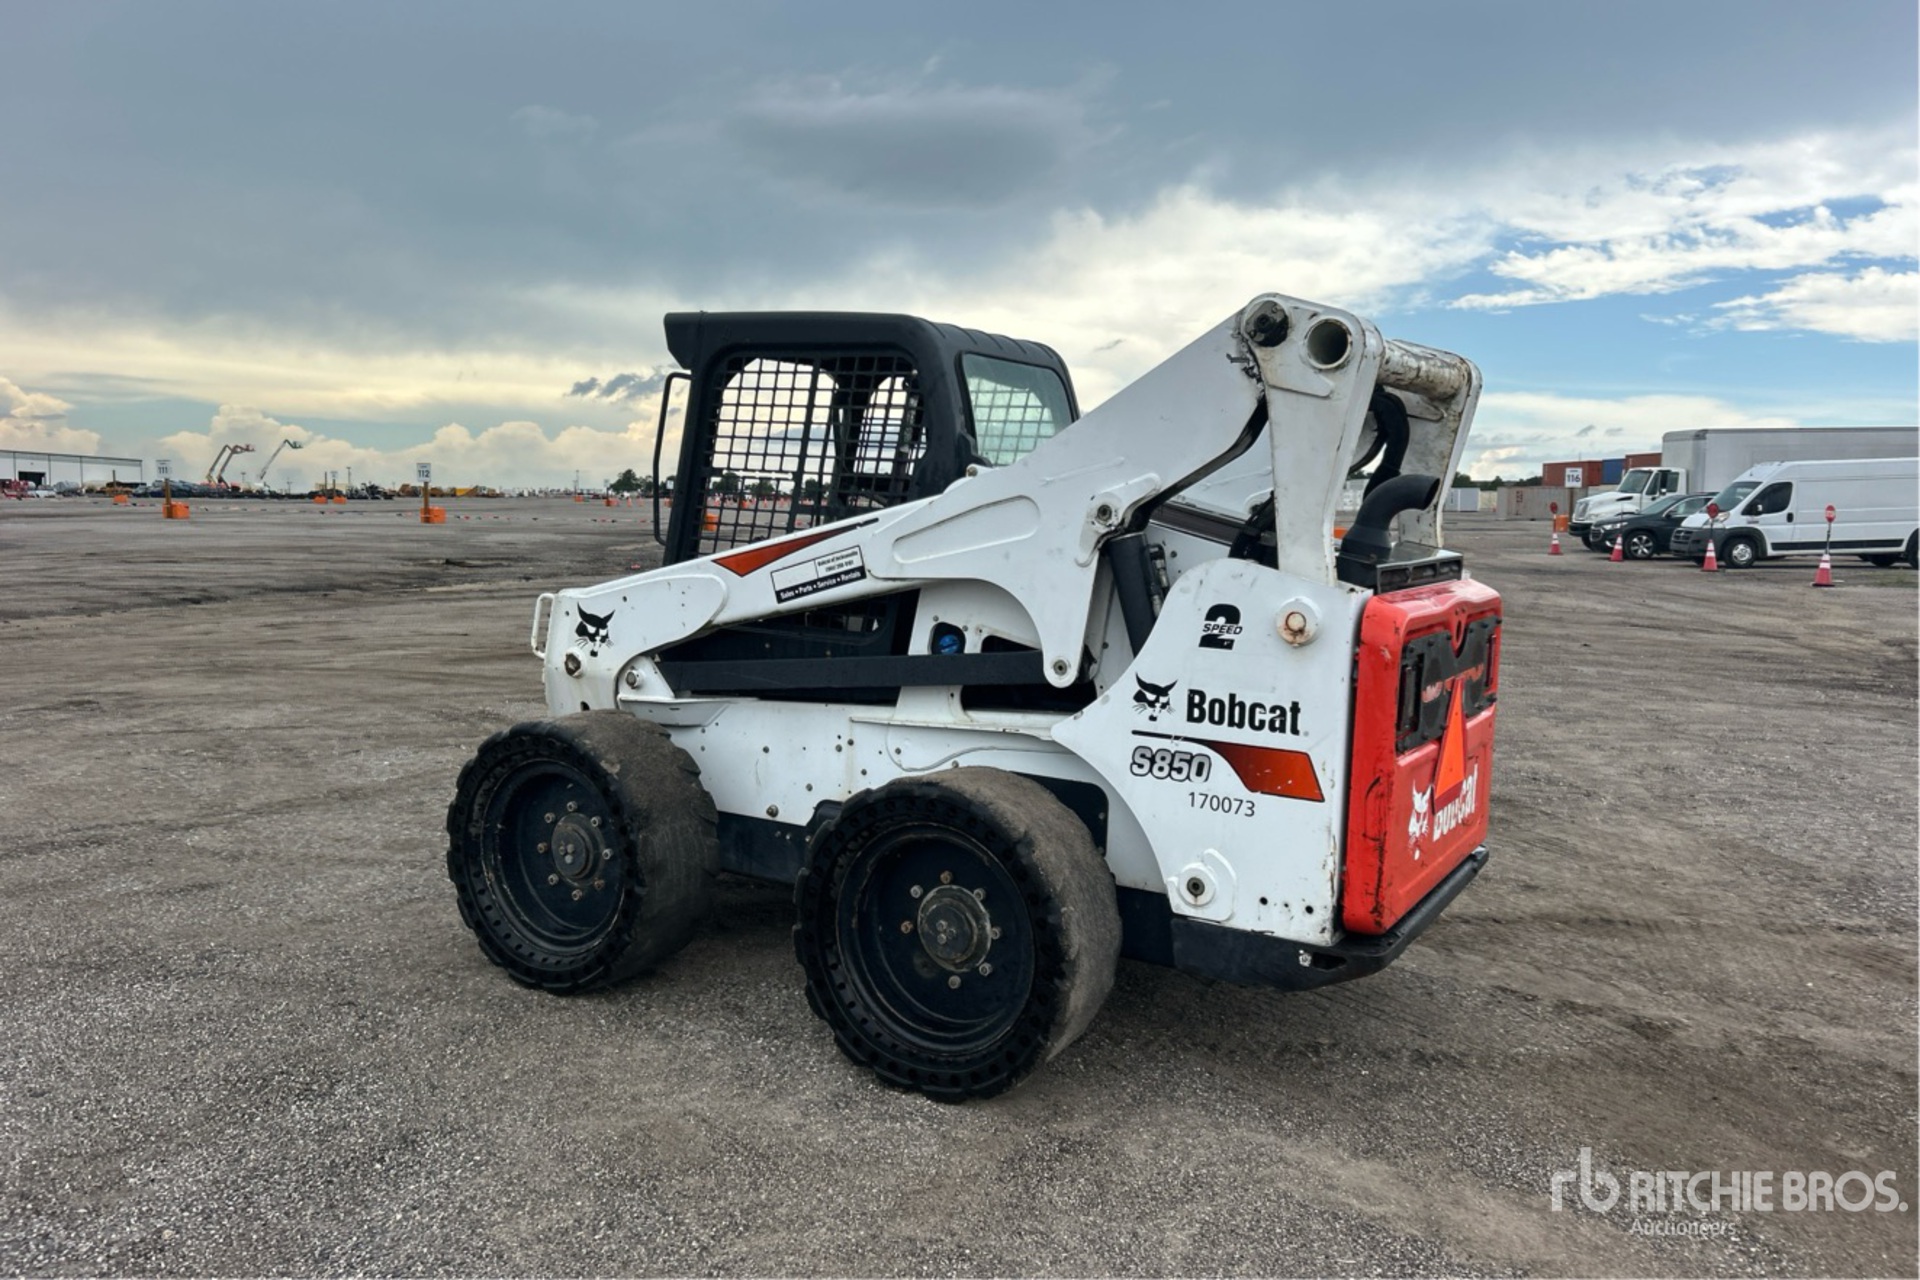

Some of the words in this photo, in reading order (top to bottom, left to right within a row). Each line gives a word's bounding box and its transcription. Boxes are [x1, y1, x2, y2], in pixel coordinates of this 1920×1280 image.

[417, 469, 430, 478] 112
[1566, 474, 1581, 483] 116
[780, 591, 795, 599] Sales
[817, 578, 836, 588] Service
[841, 571, 861, 581] Rentals
[1198, 603, 1241, 650] 2
[1202, 623, 1243, 635] SPEED
[1186, 688, 1301, 736] Bobcat
[1130, 745, 1212, 783] S850
[1188, 791, 1256, 818] 170073
